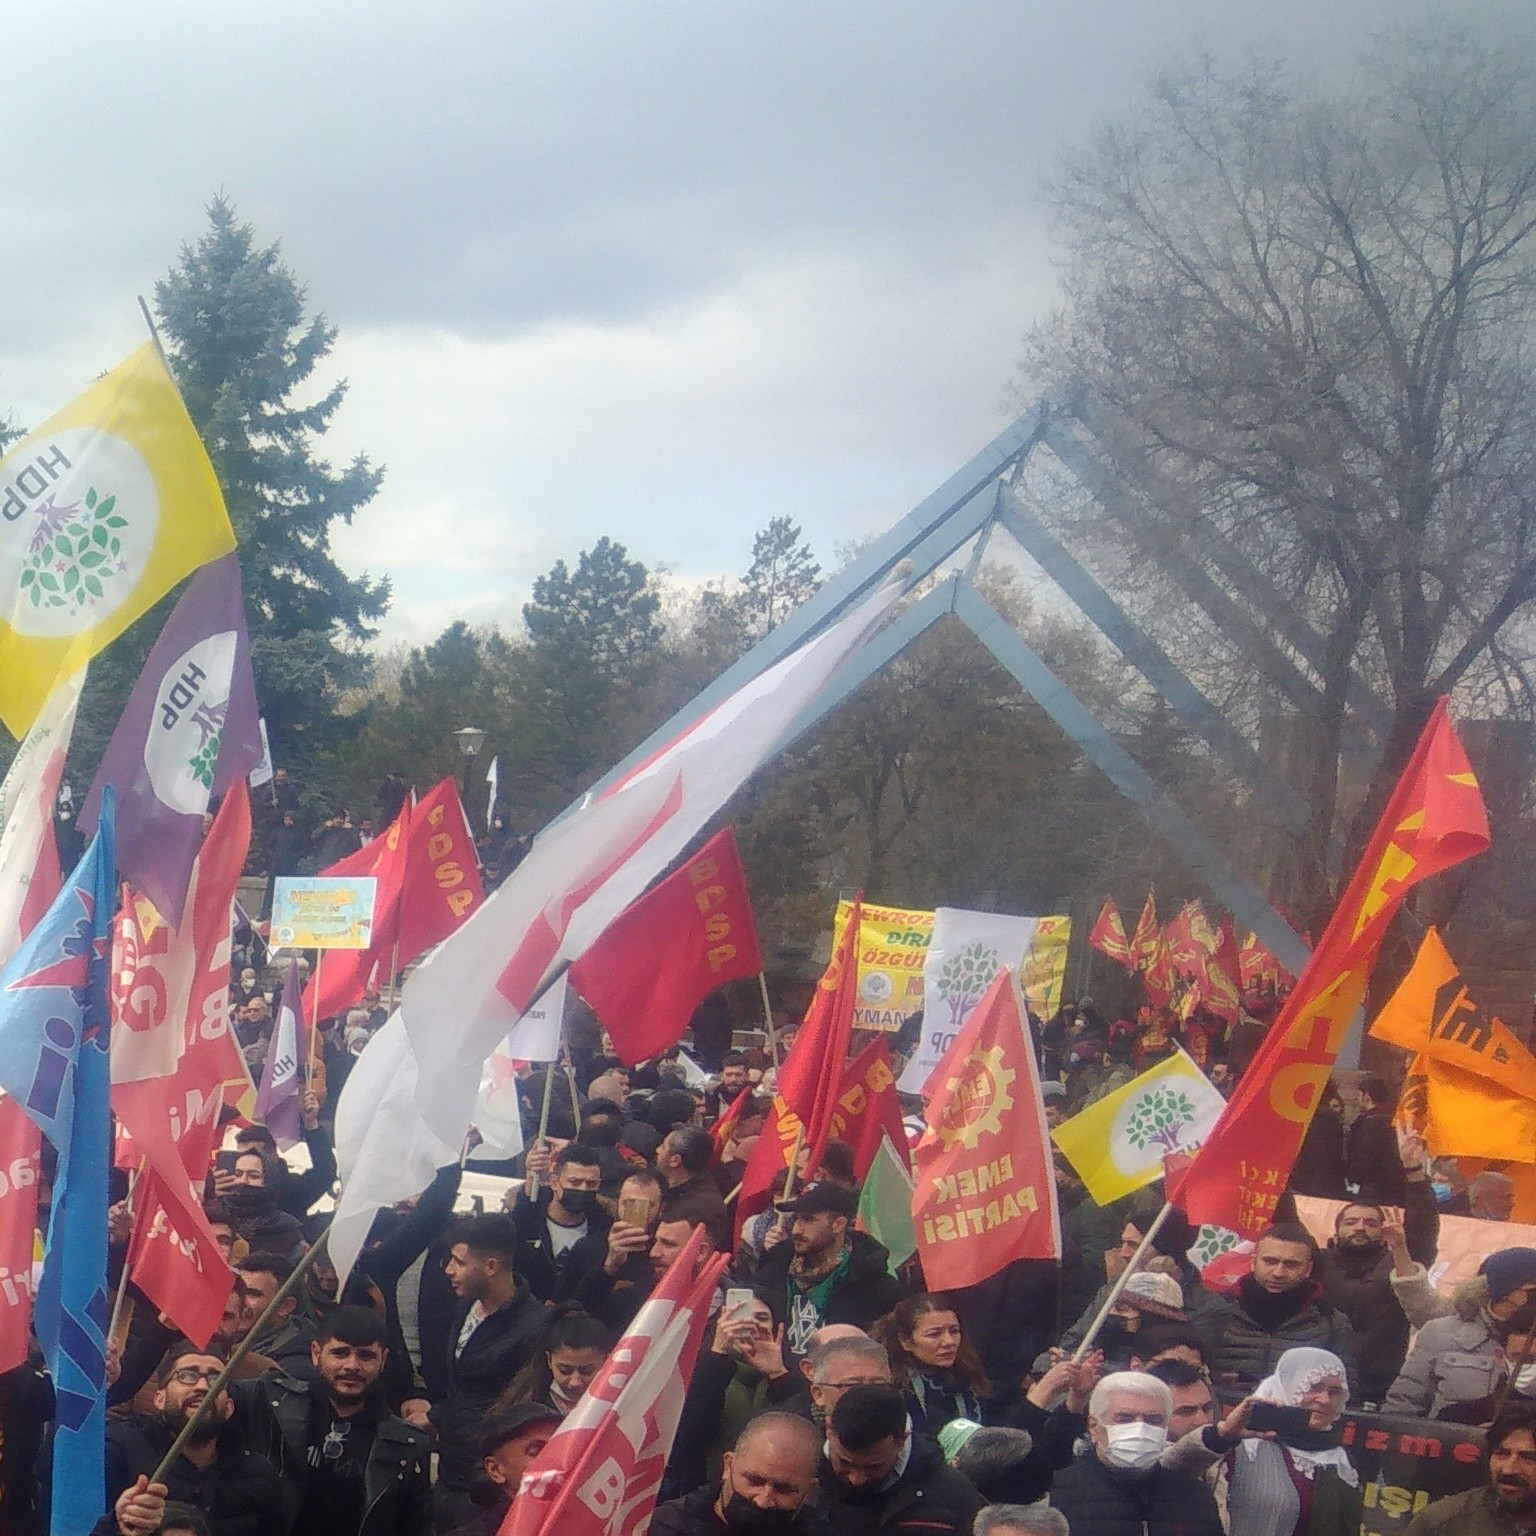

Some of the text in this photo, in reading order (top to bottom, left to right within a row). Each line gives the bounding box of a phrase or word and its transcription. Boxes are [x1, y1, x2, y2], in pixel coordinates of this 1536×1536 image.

[1, 444, 72, 522] HDP
[160, 661, 207, 731] HDP
[1341, 1420, 1481, 1464] izme
